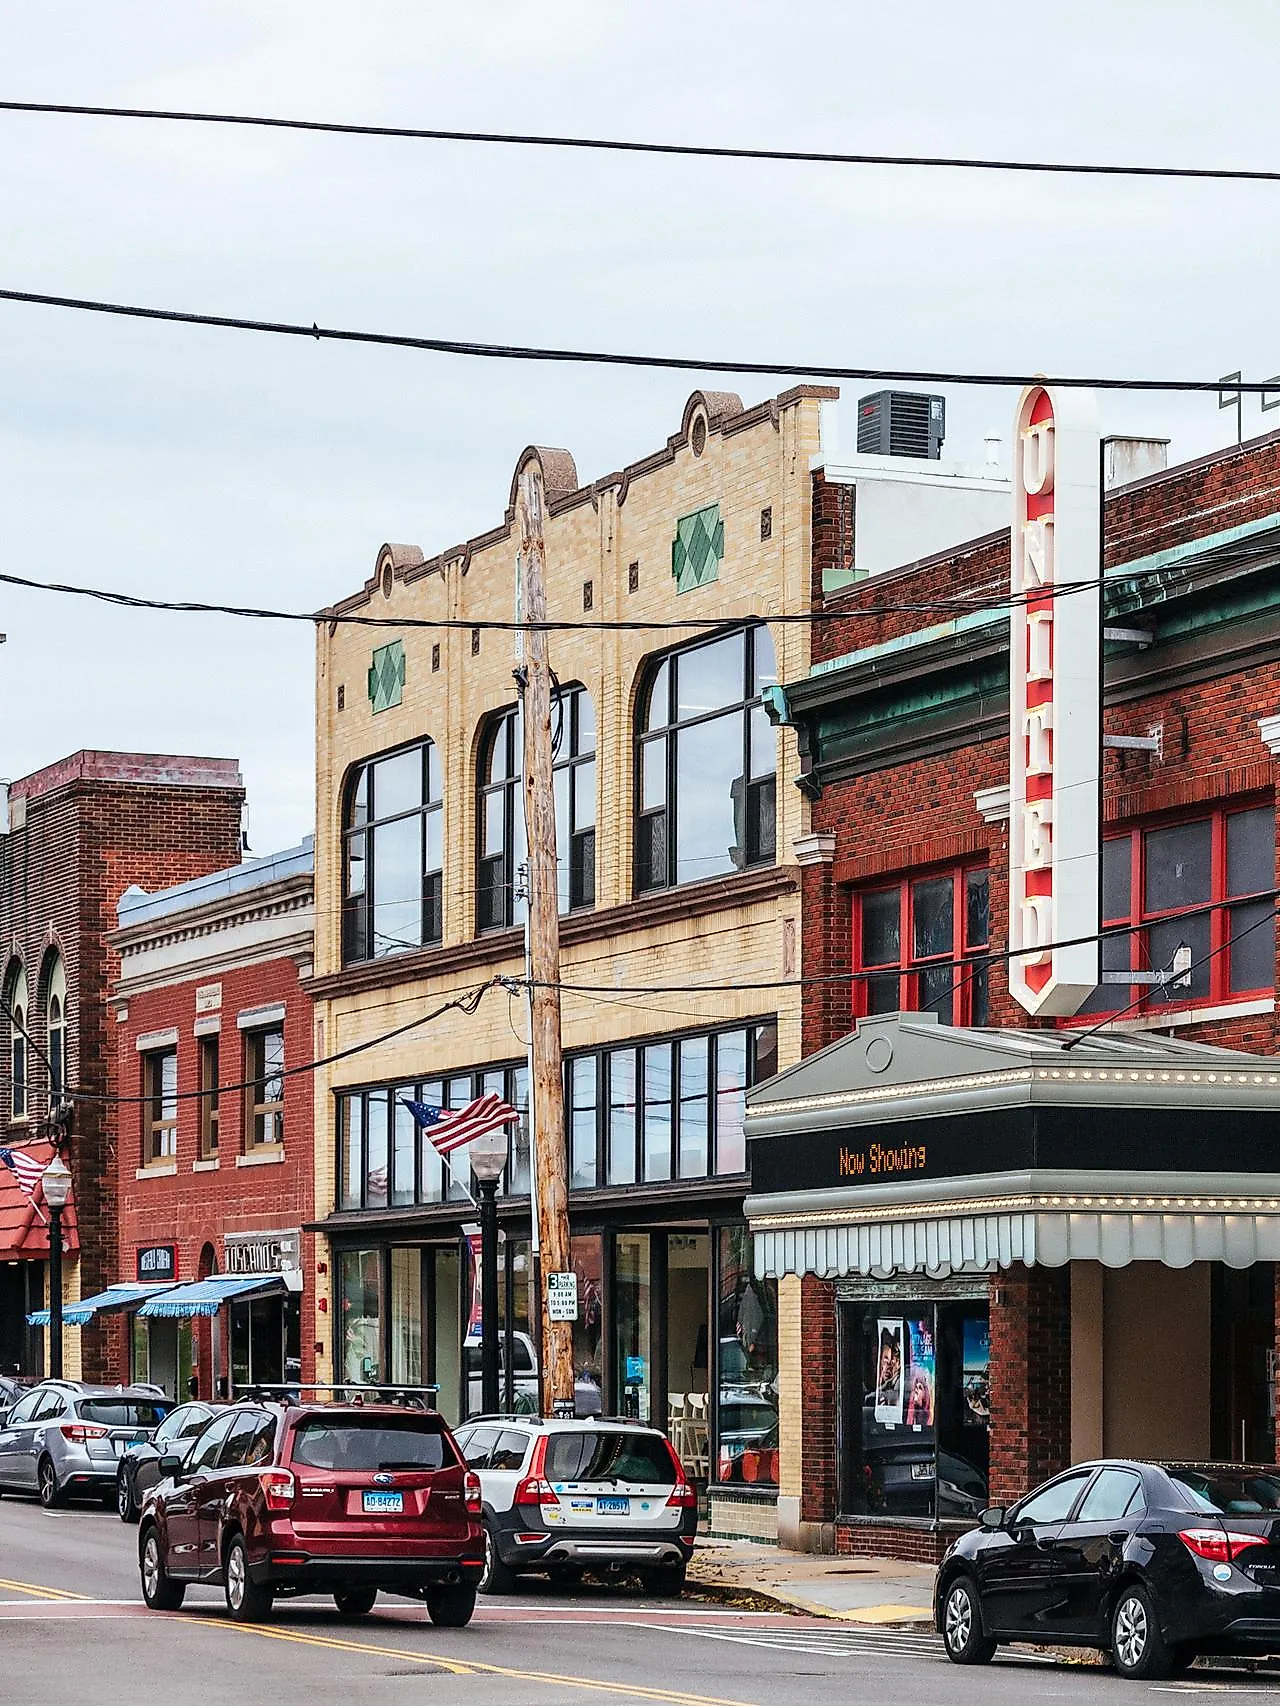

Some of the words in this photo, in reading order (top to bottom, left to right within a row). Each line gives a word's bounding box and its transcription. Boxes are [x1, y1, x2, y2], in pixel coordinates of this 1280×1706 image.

[1021, 421, 1055, 967] UNITED
[839, 1146, 865, 1176] Now
[869, 1141, 926, 1173] Showing
[550, 1274, 558, 1289] 3
